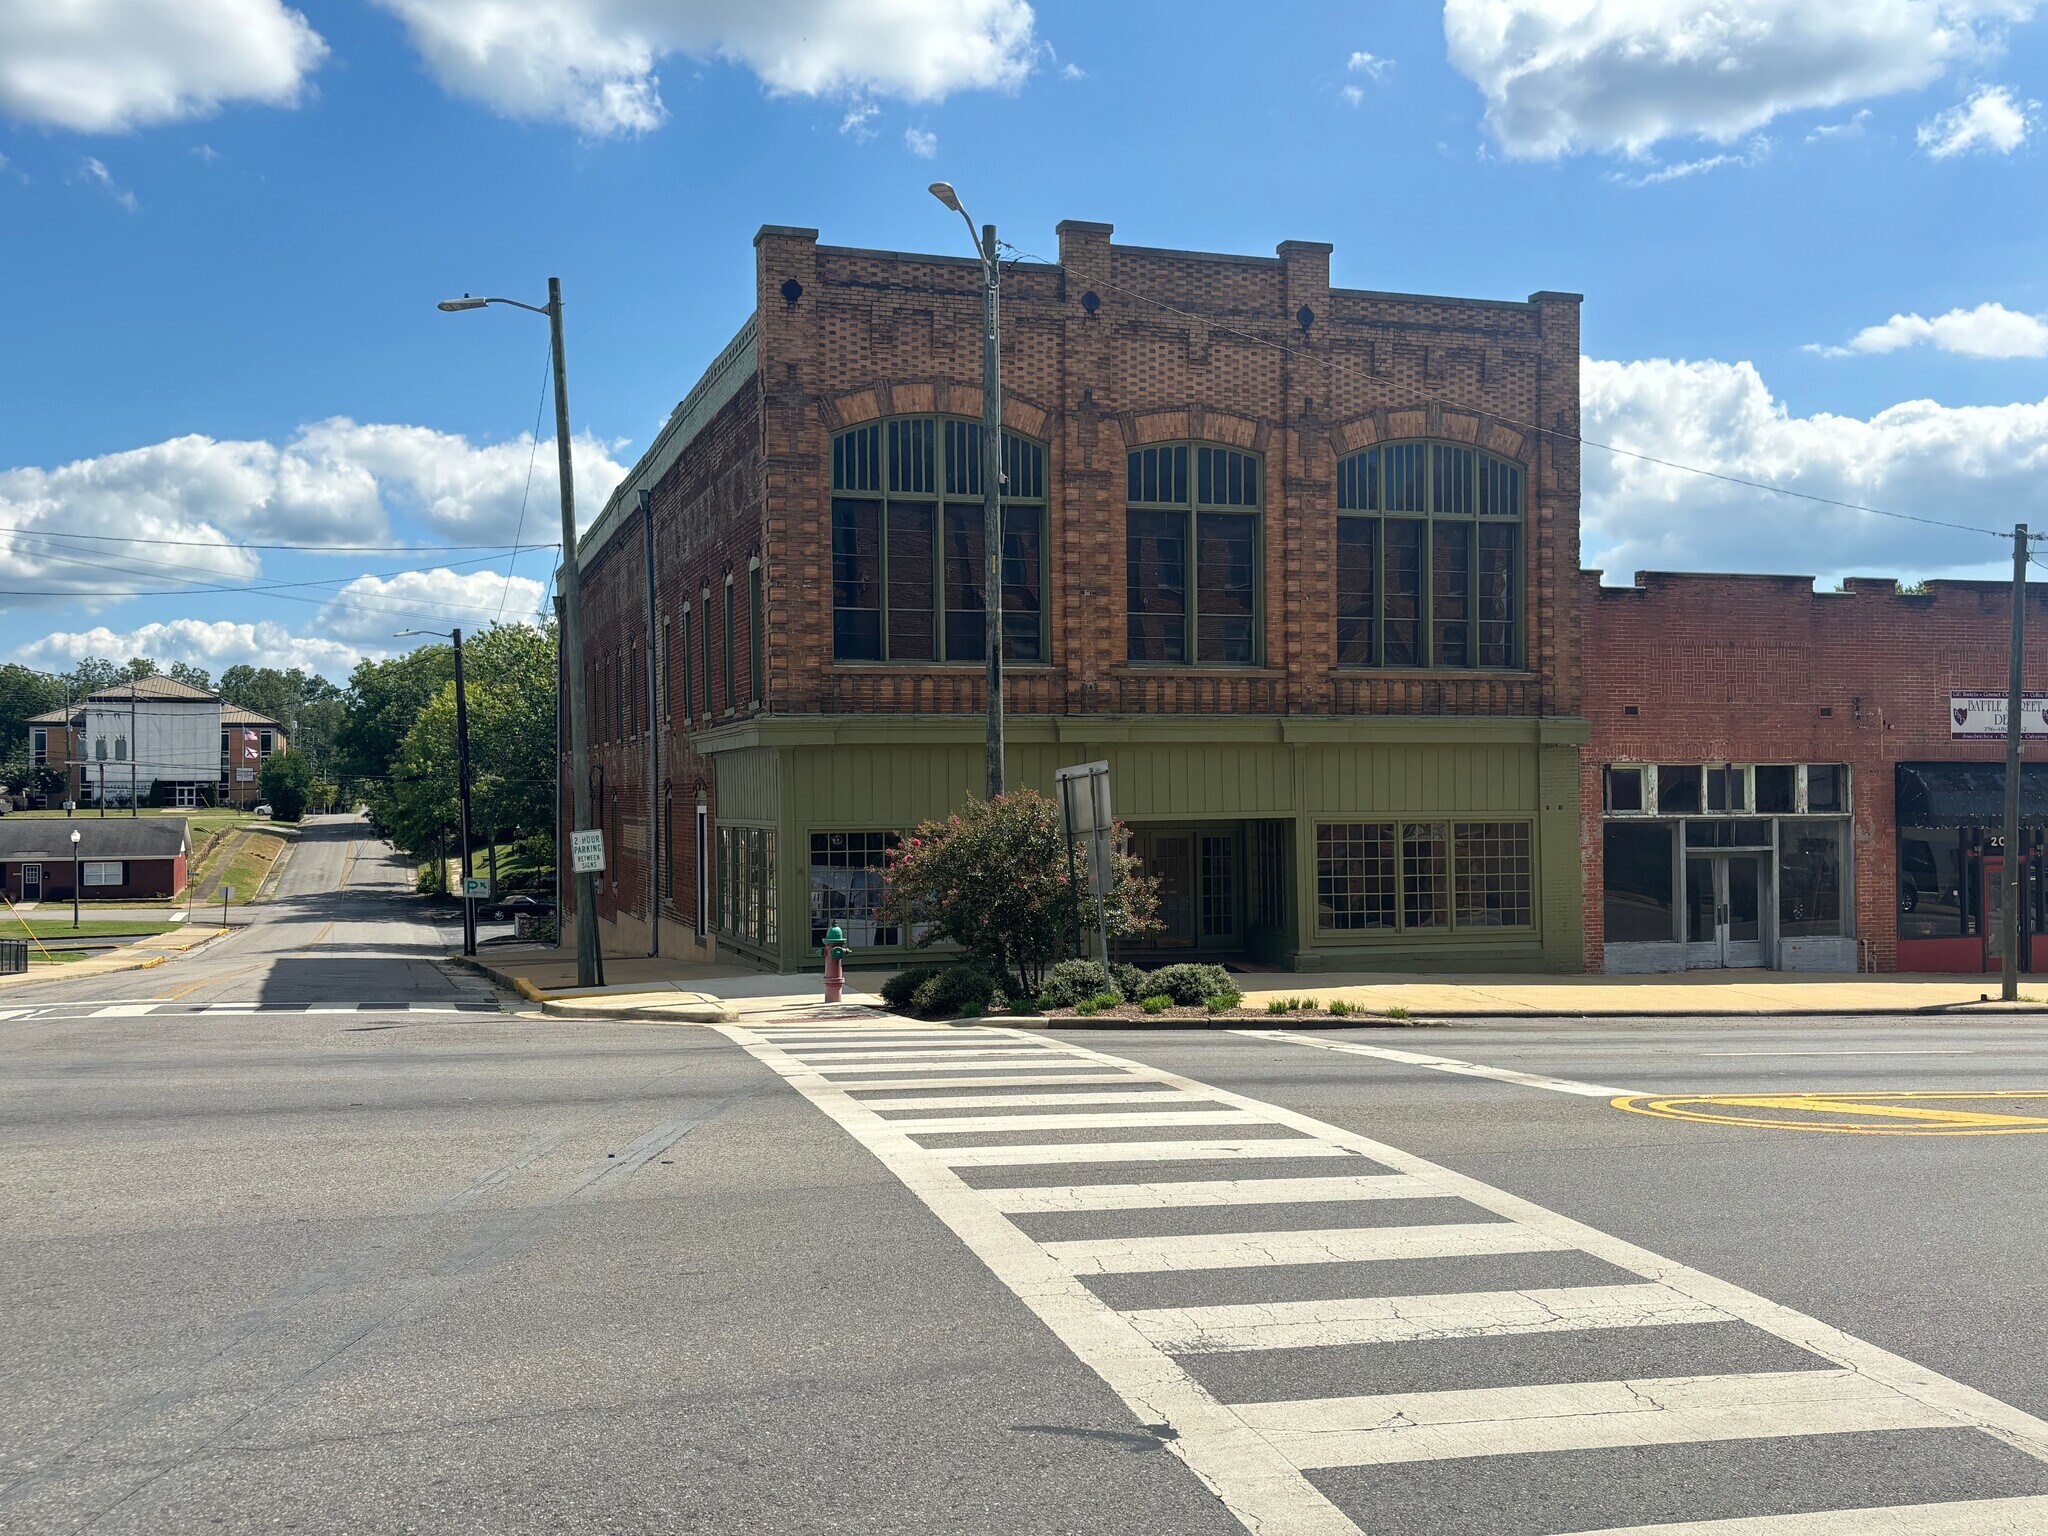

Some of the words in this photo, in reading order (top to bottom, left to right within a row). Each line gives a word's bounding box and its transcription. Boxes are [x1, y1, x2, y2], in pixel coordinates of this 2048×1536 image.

[1968, 700, 2001, 711] BATTLE
[574, 837, 578, 845] 2
[582, 835, 600, 844] HOUR
[574, 844, 601, 854] PARKING
[468, 881, 478, 894] P
